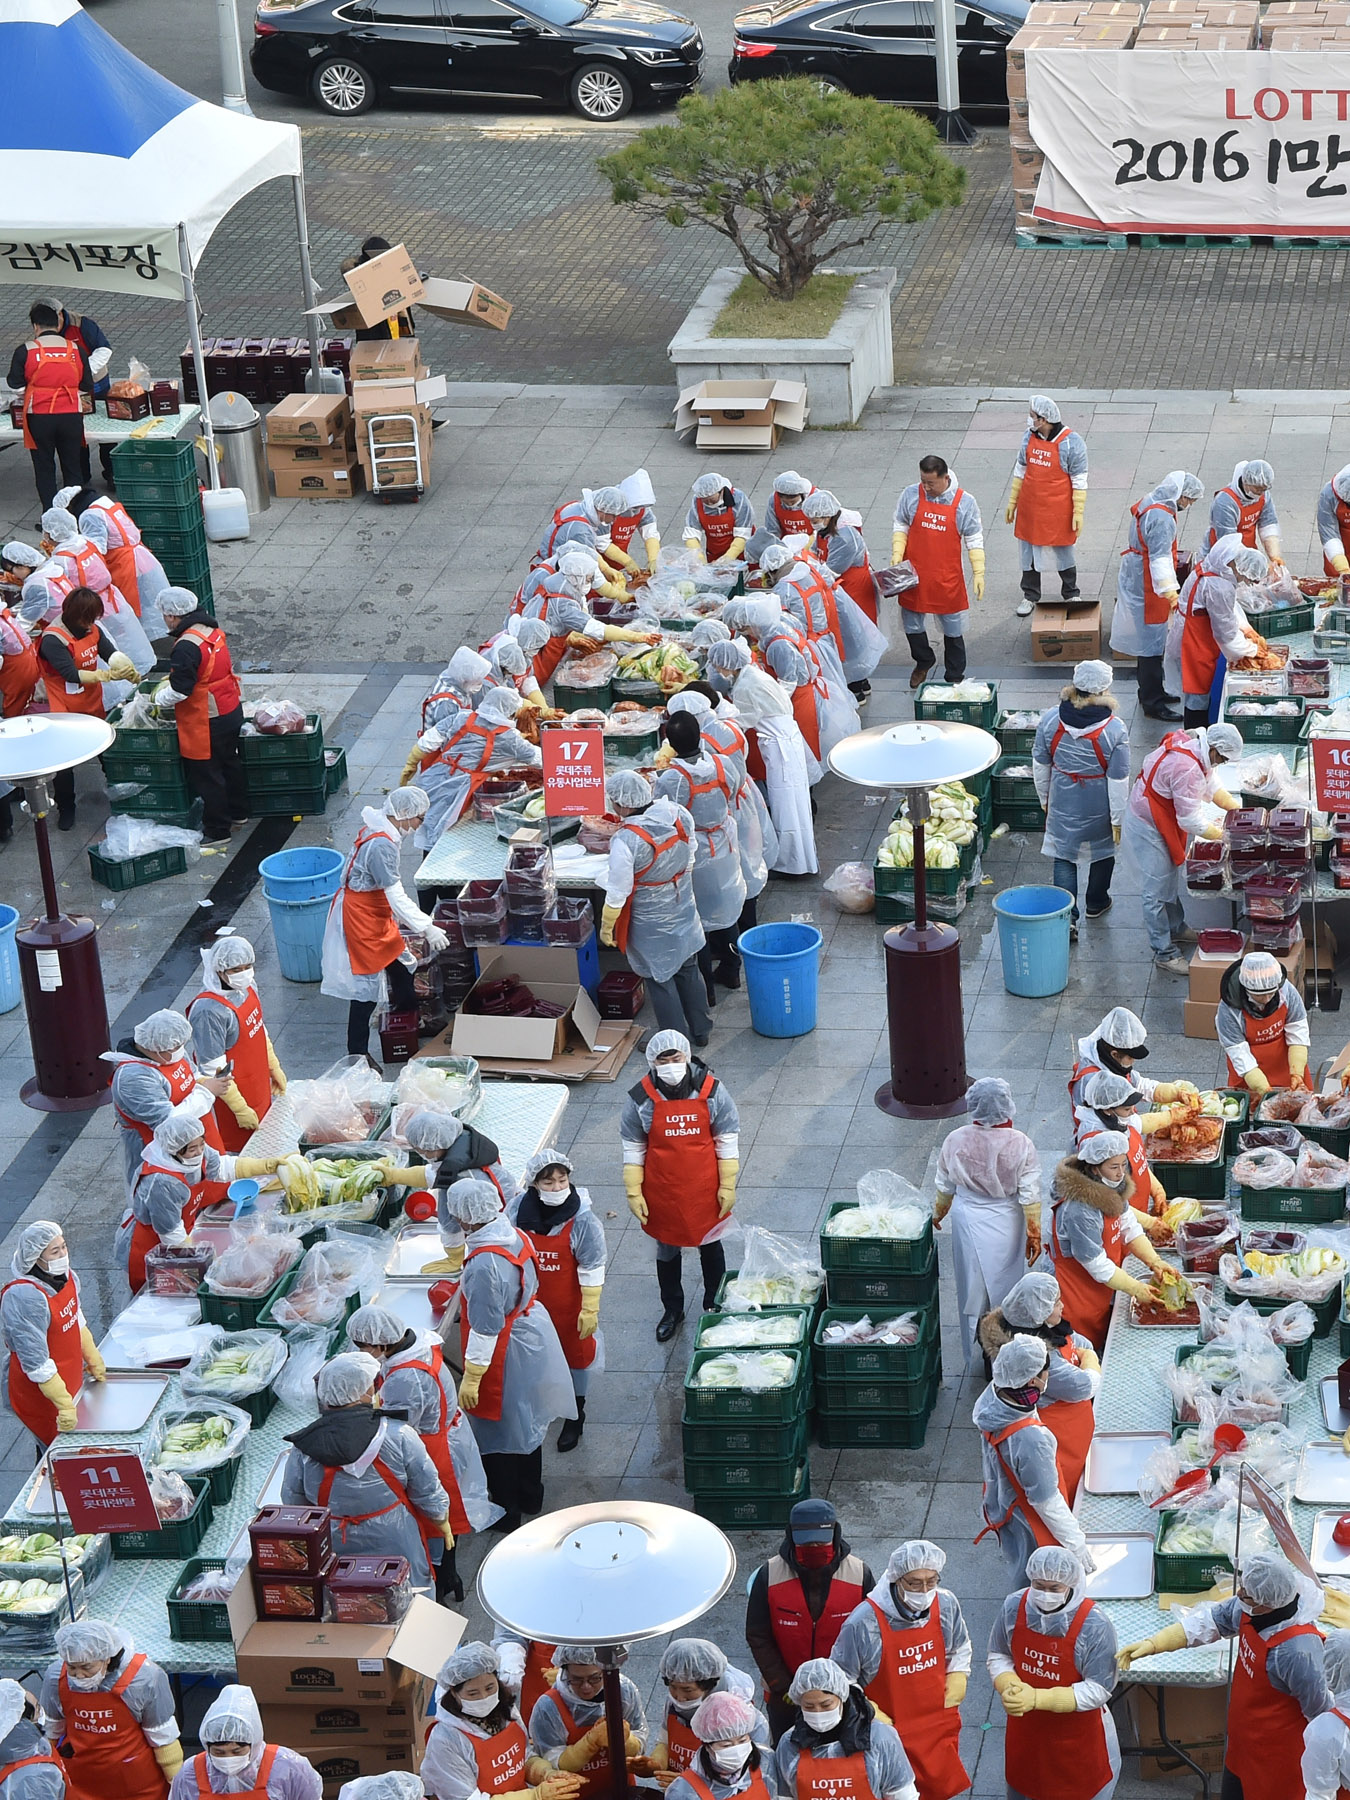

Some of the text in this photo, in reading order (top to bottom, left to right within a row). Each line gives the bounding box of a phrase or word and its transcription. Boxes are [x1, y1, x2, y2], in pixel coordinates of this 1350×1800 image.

[1112, 129, 1250, 185] 2016
[2, 242, 162, 280] 김치포장
[1032, 448, 1052, 458] LOTTE
[1029, 457, 1051, 467] BUSAN
[924, 512, 946, 522] LOTTE
[707, 523, 729, 531] LOTTE
[921, 522, 946, 532] BUSAN
[558, 741, 589, 761] 17
[555, 765, 593, 776] 롯데주류
[546, 777, 603, 789] 유통사업본부
[245, 1007, 260, 1026] LOTTE
[1257, 1019, 1283, 1036] LOTTE
[666, 1114, 698, 1123] LOTTE
[664, 1127, 700, 1137] BUSAN
[539, 1263, 561, 1272] SAN
[59, 1296, 77, 1318] LOTTE
[80, 1466, 122, 1485] 11
[79, 1485, 132, 1499] 롯데푸드
[82, 1497, 136, 1509] 롯데렌탈
[898, 1640, 935, 1658] LOTTE
[1024, 1646, 1060, 1666] LOTTE
[898, 1656, 938, 1675] BUSAN
[1021, 1662, 1061, 1681] BUSAN
[74, 1708, 113, 1719] LOTTE
[74, 1721, 117, 1734] BUSAN
[491, 1742, 521, 1768] LOTTE
[581, 1757, 609, 1772] BUS
[493, 1760, 525, 1787] BUSAN
[812, 1777, 852, 1790] LOTTE
